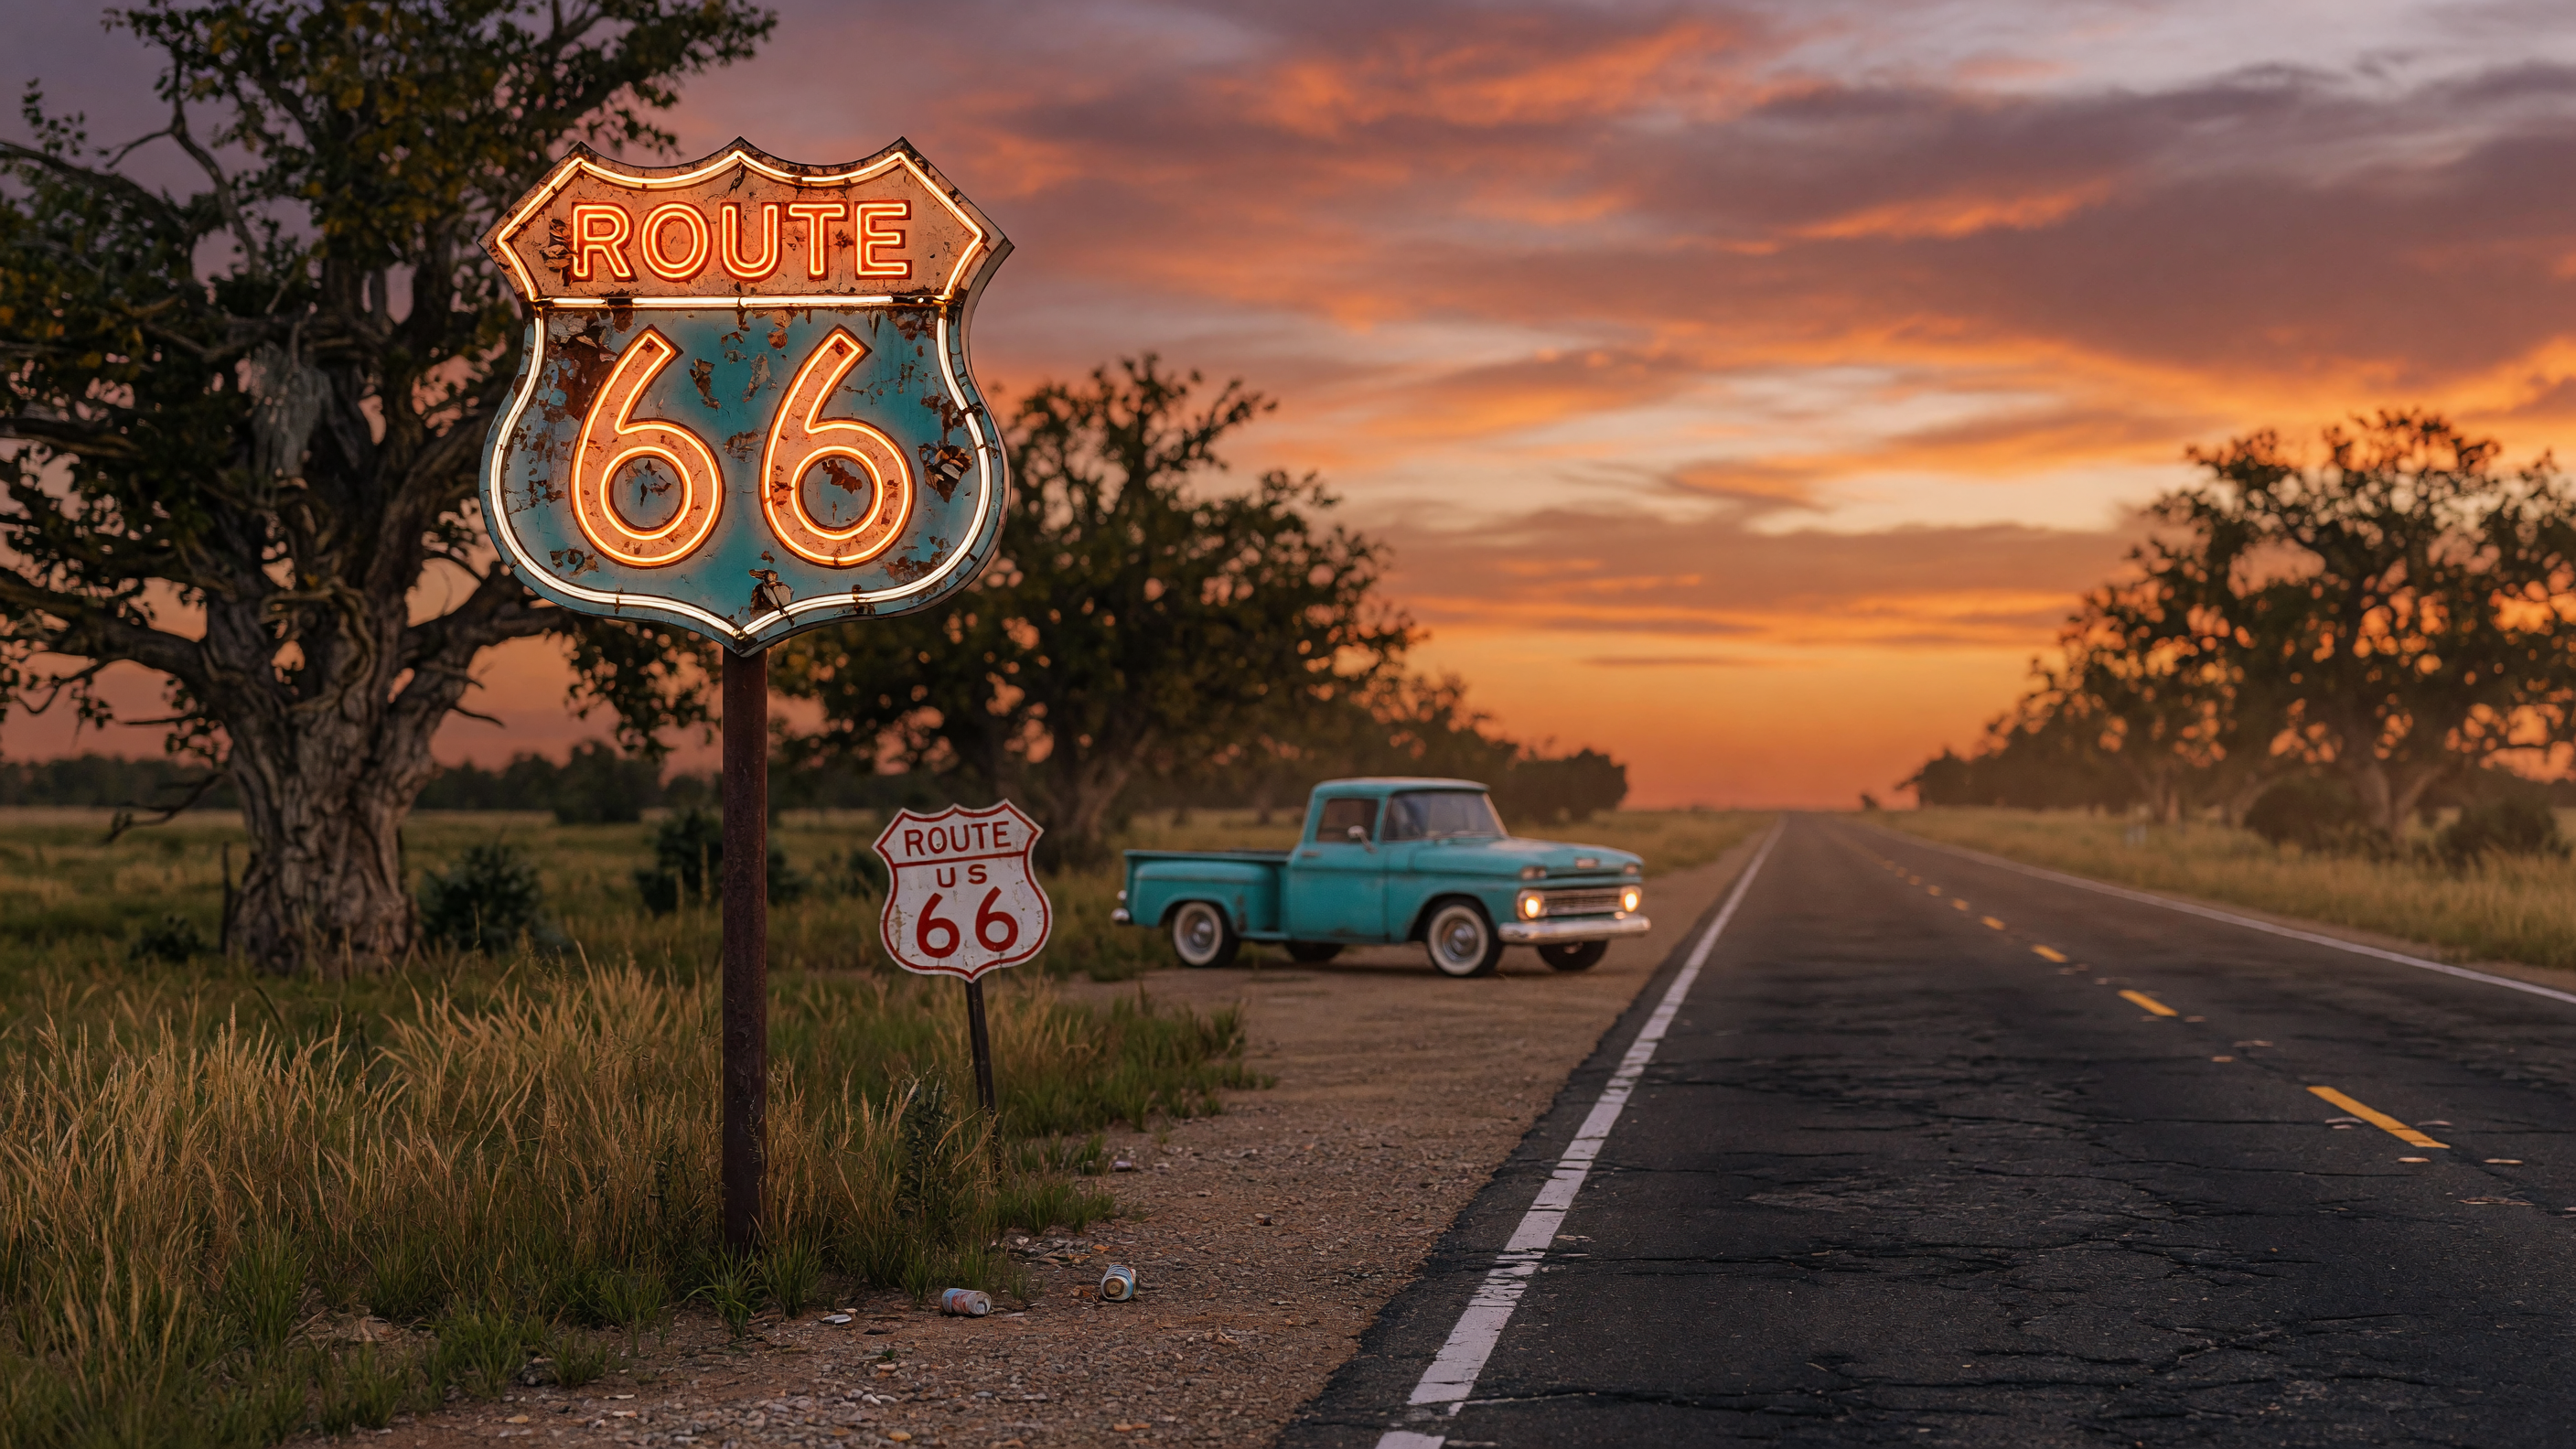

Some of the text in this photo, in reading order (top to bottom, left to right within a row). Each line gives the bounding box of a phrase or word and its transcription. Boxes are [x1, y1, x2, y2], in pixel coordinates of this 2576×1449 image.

[572, 201, 912, 282] ROUTE
[570, 324, 915, 568] 66
[904, 821, 1012, 857] ROUTE
[917, 886, 1019, 959] 66
